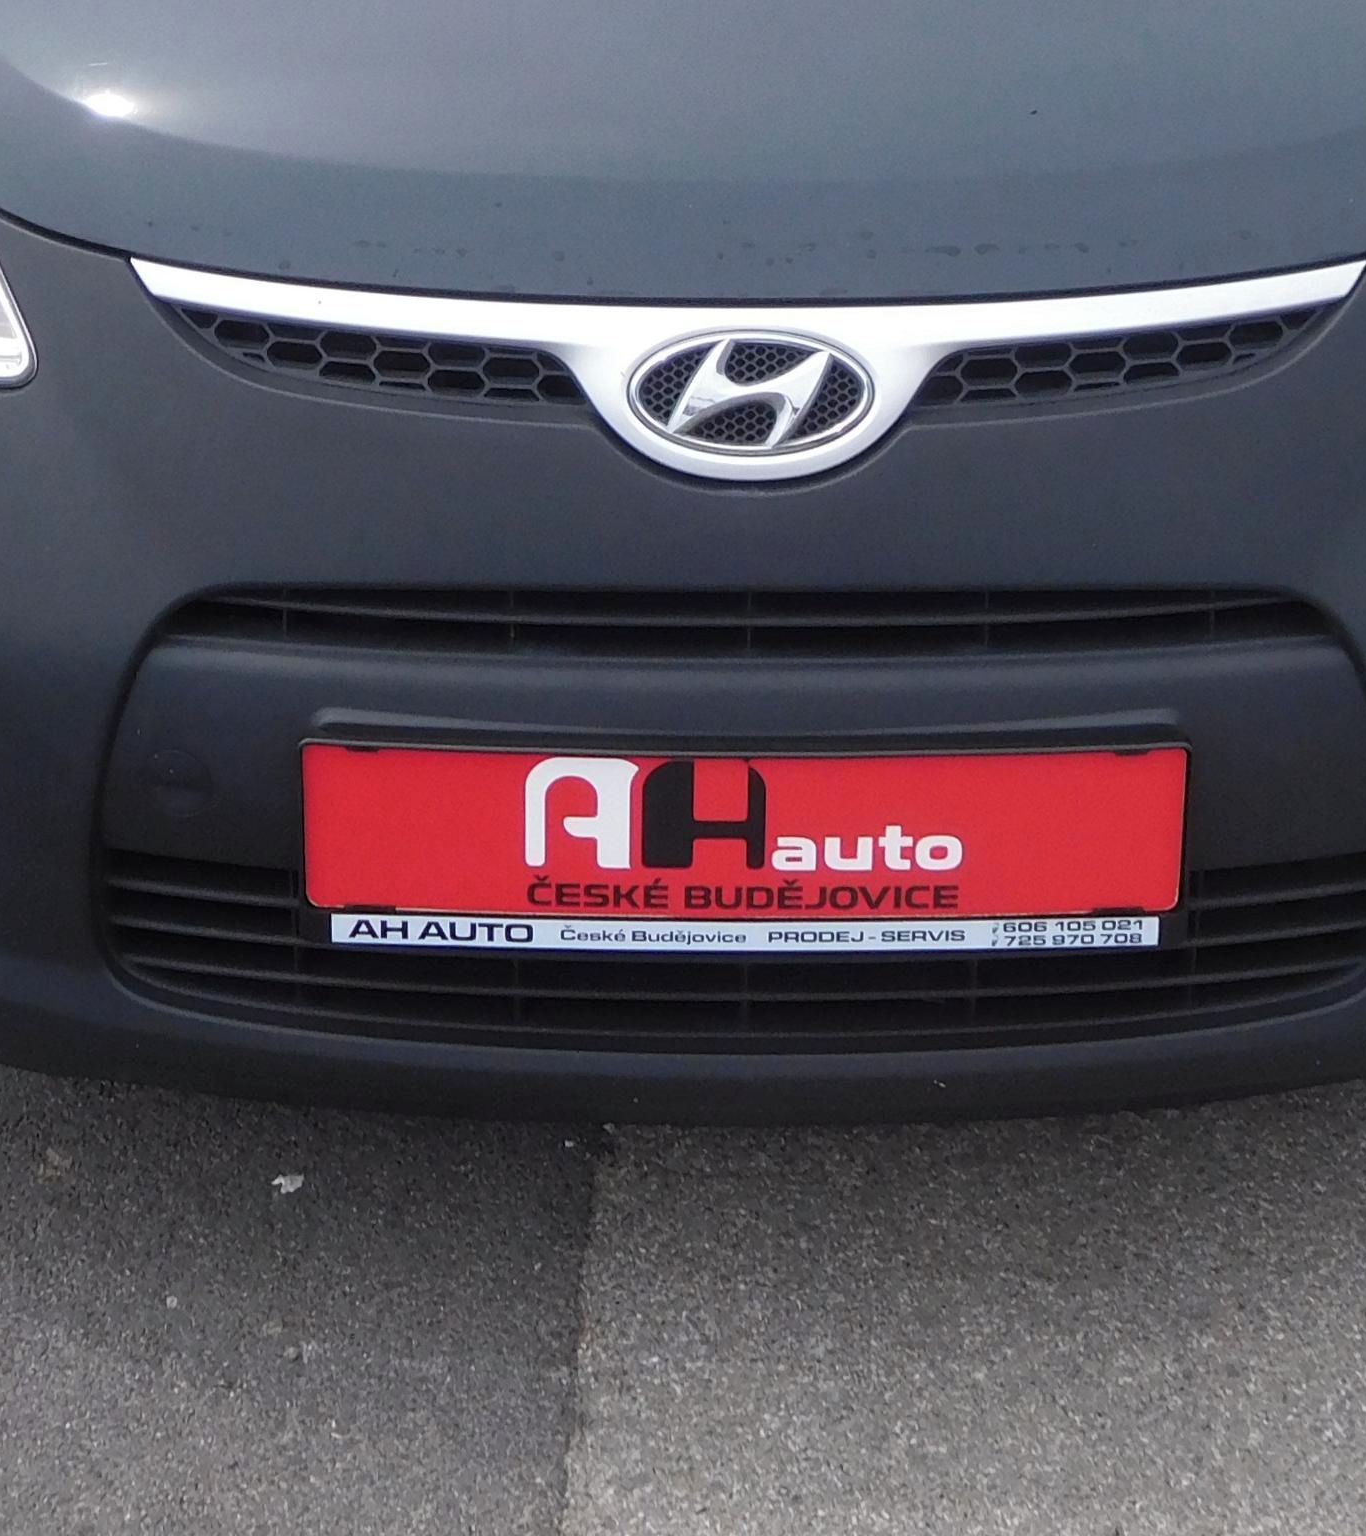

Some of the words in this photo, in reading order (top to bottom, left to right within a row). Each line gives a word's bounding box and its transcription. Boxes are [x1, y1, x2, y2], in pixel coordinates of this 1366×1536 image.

[524, 757, 767, 870] AH
[771, 824, 964, 872] auto
[526, 874, 669, 909] ČESKÉ
[684, 878, 960, 911] BUDĚJOVICE
[348, 919, 409, 940] AH
[418, 920, 534, 943] AUTO
[560, 925, 626, 942] České
[631, 929, 747, 946] Budějovice
[768, 930, 865, 943] PRODEJ
[881, 929, 966, 943] SERVIS
[1003, 921, 1048, 933] 606
[1055, 920, 1097, 932] 105
[1101, 919, 1143, 931] 021
[1004, 935, 1047, 947] 725
[1052, 934, 1095, 946] 970
[1100, 933, 1143, 945] 708
